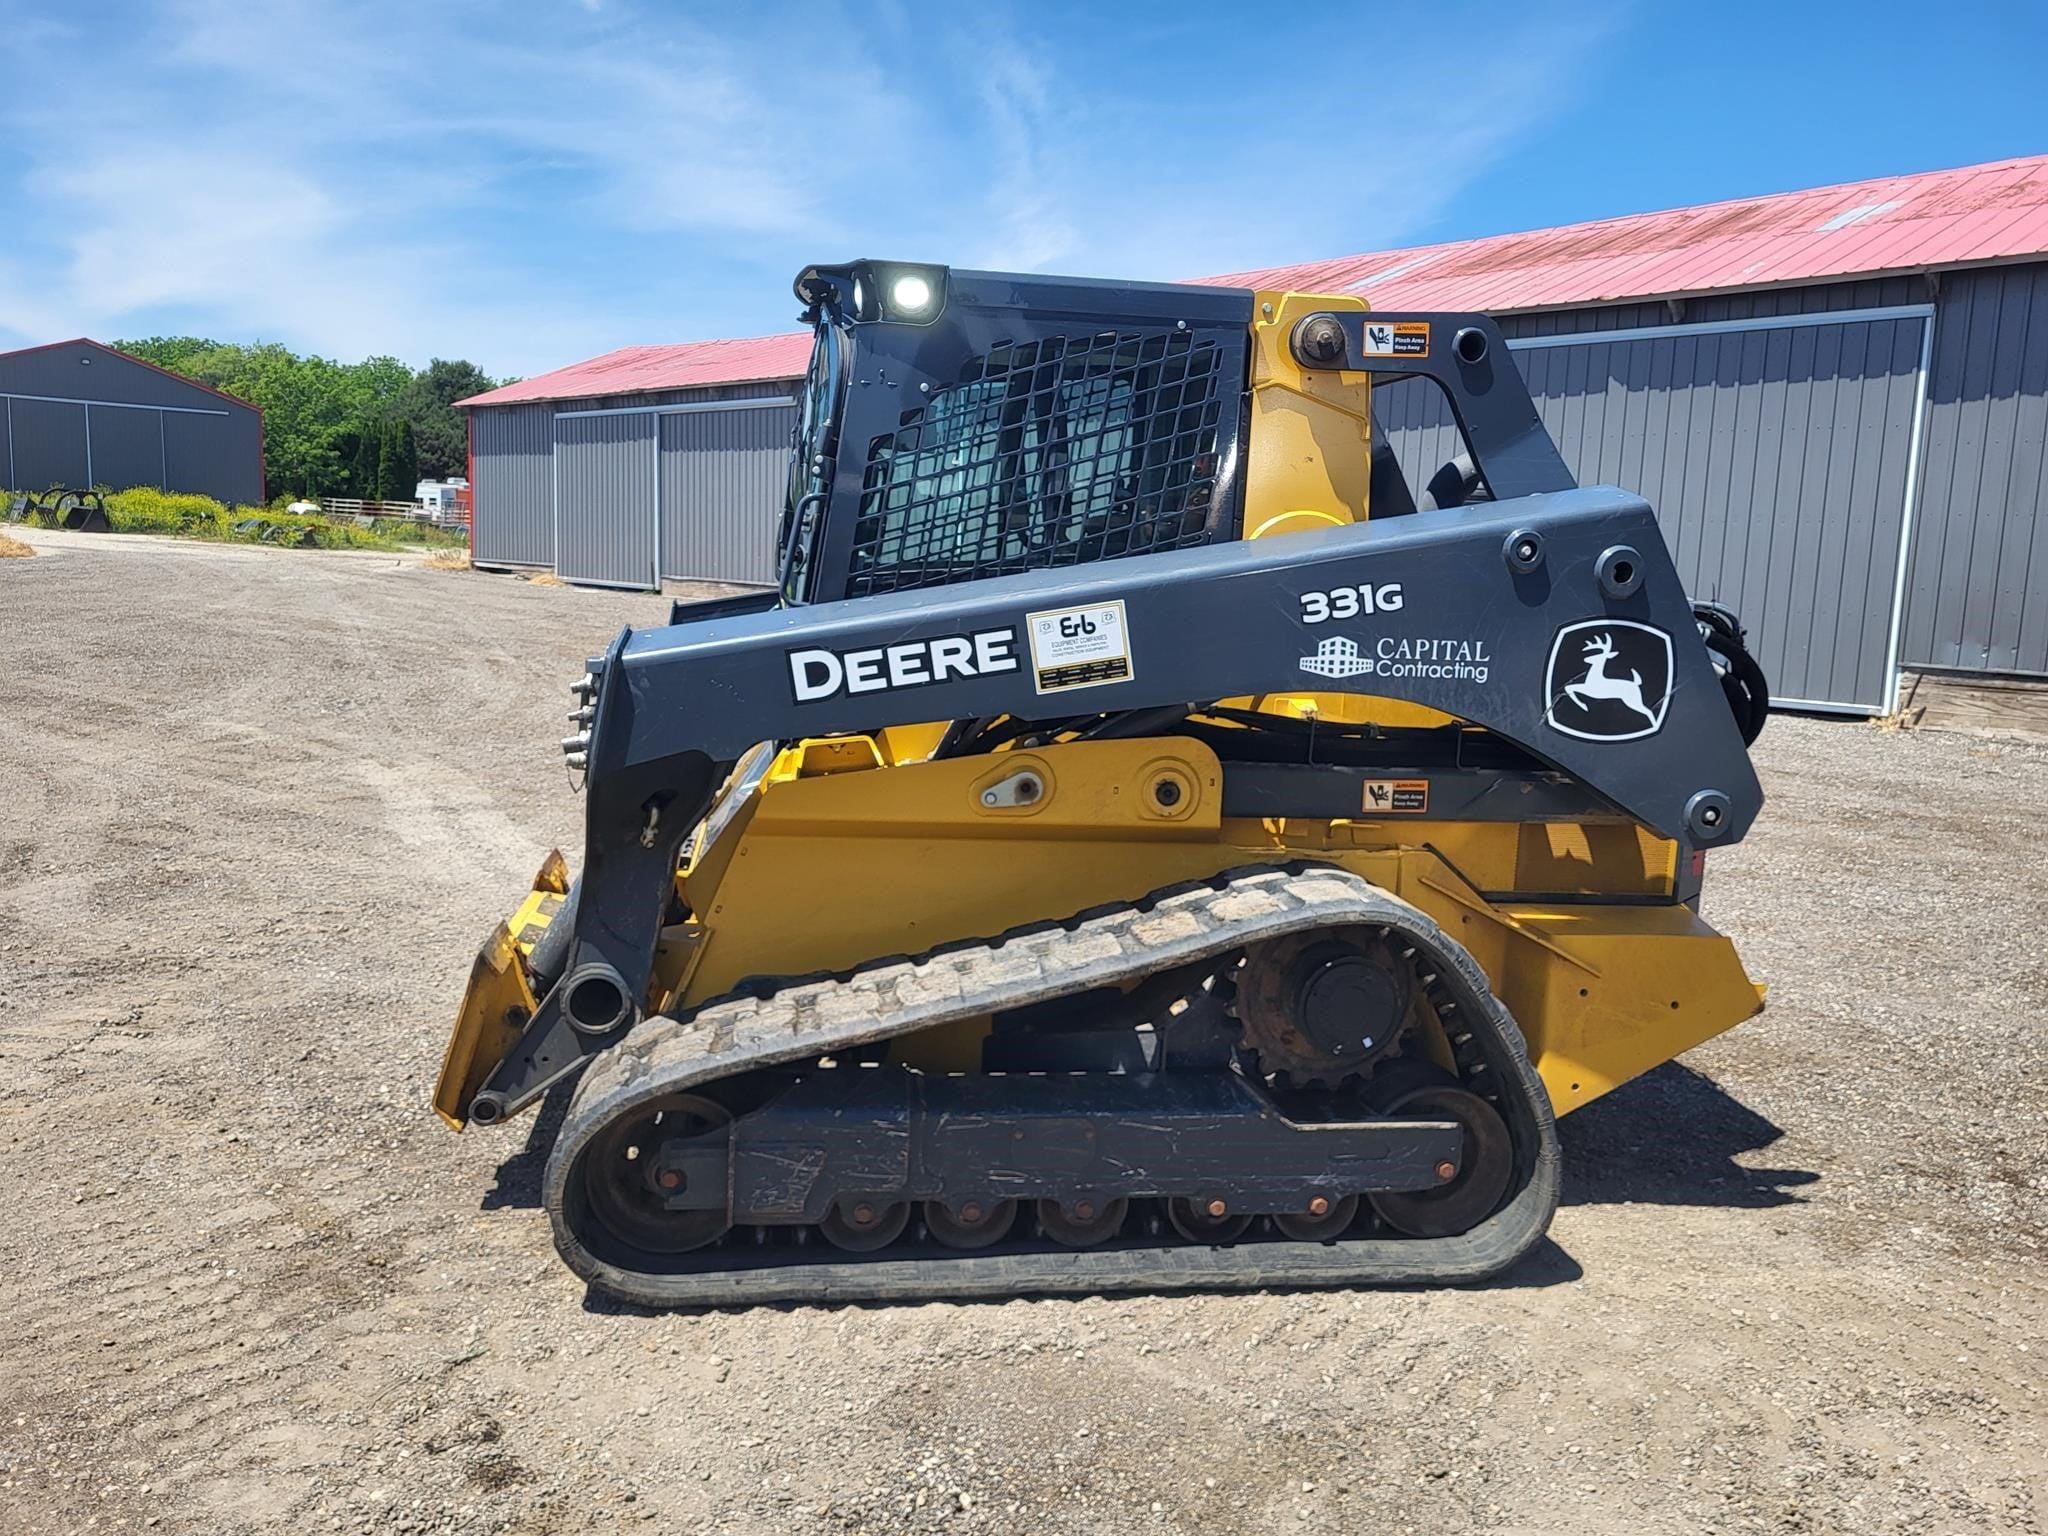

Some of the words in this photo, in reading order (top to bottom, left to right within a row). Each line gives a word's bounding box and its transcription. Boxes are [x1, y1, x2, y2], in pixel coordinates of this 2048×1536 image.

[1300, 583, 1404, 623] 331G
[1059, 614, 1097, 638] Erb
[1376, 637, 1491, 662] CAPITAL
[789, 629, 1017, 701] DEERE
[1376, 659, 1489, 684] Contracting
